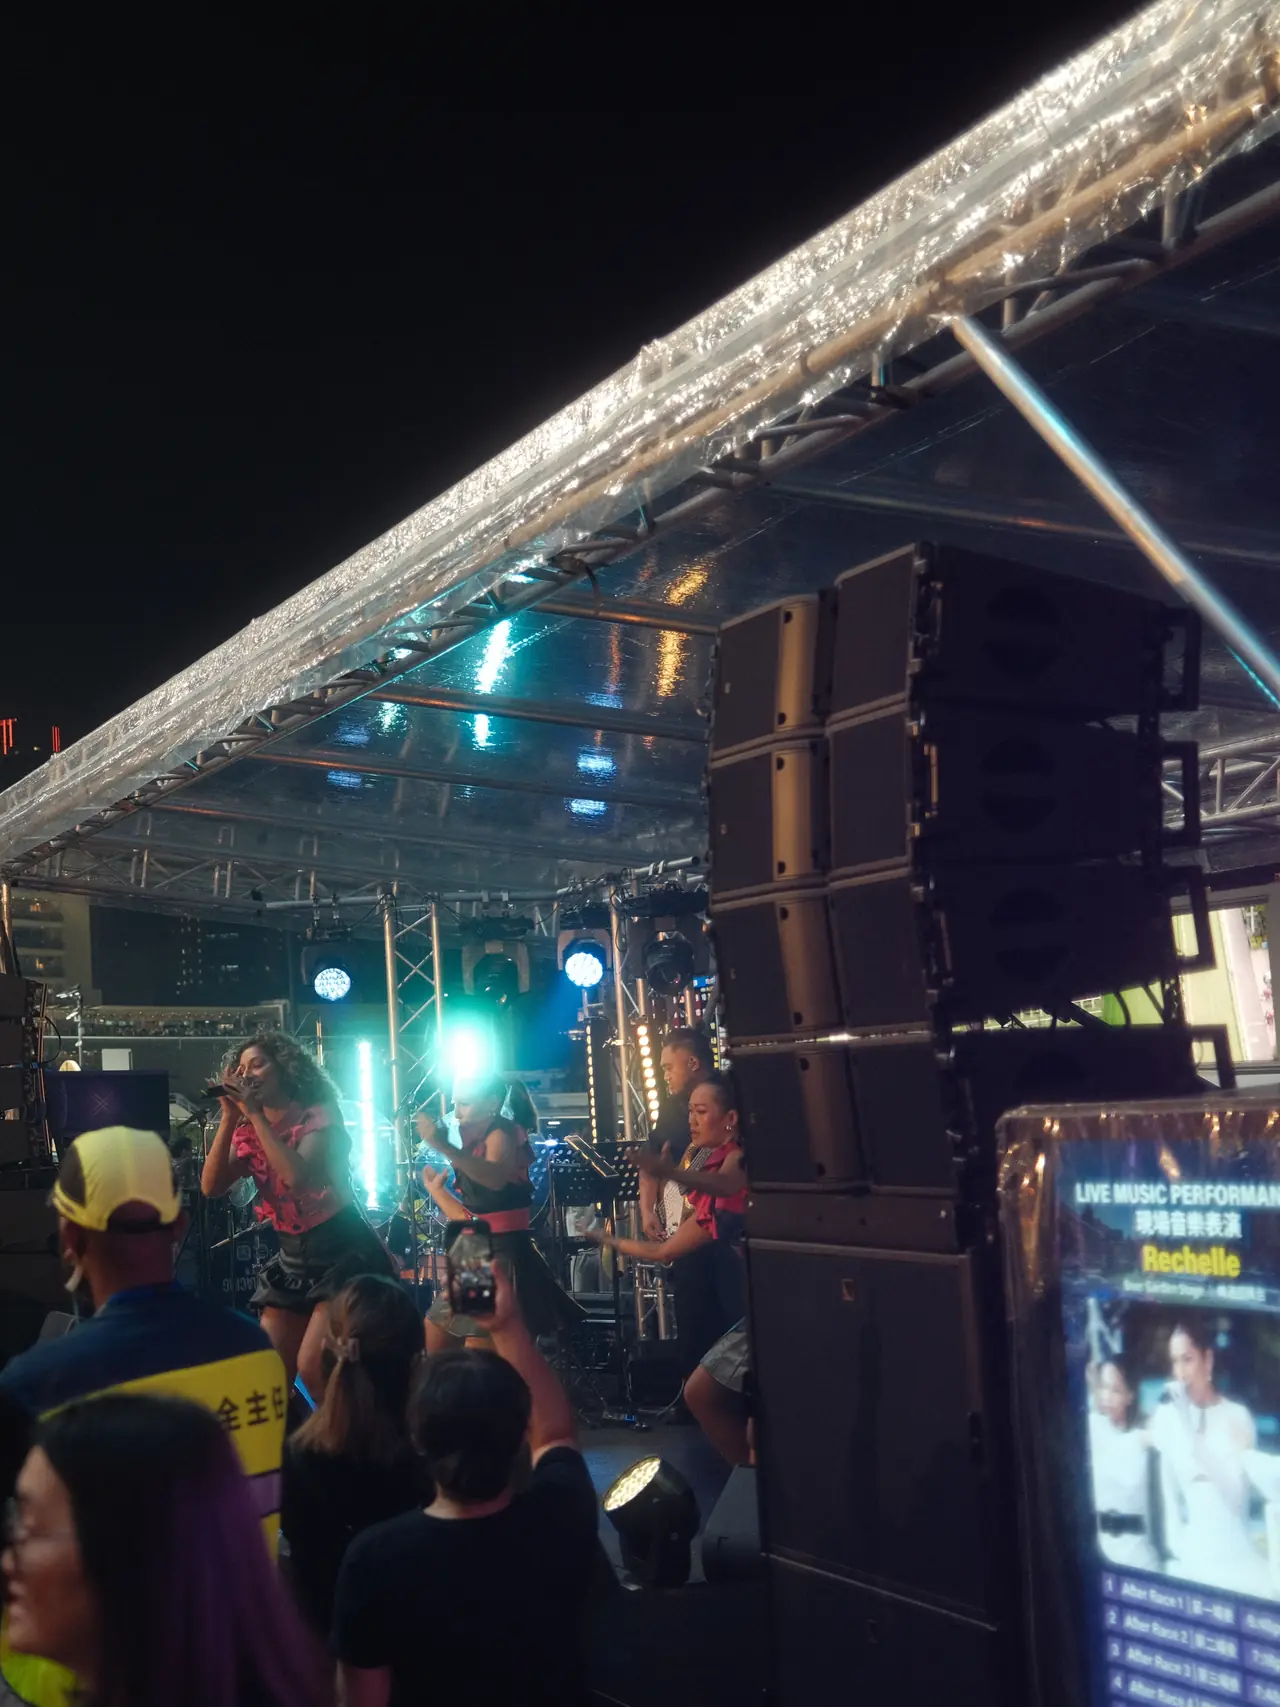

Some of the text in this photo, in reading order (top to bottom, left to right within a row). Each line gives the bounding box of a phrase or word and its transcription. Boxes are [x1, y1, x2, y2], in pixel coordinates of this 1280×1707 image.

[1075, 1183, 1110, 1203] LIVE
[1113, 1184, 1168, 1204] MUSIC
[1142, 1244, 1241, 1279] Rechelle
